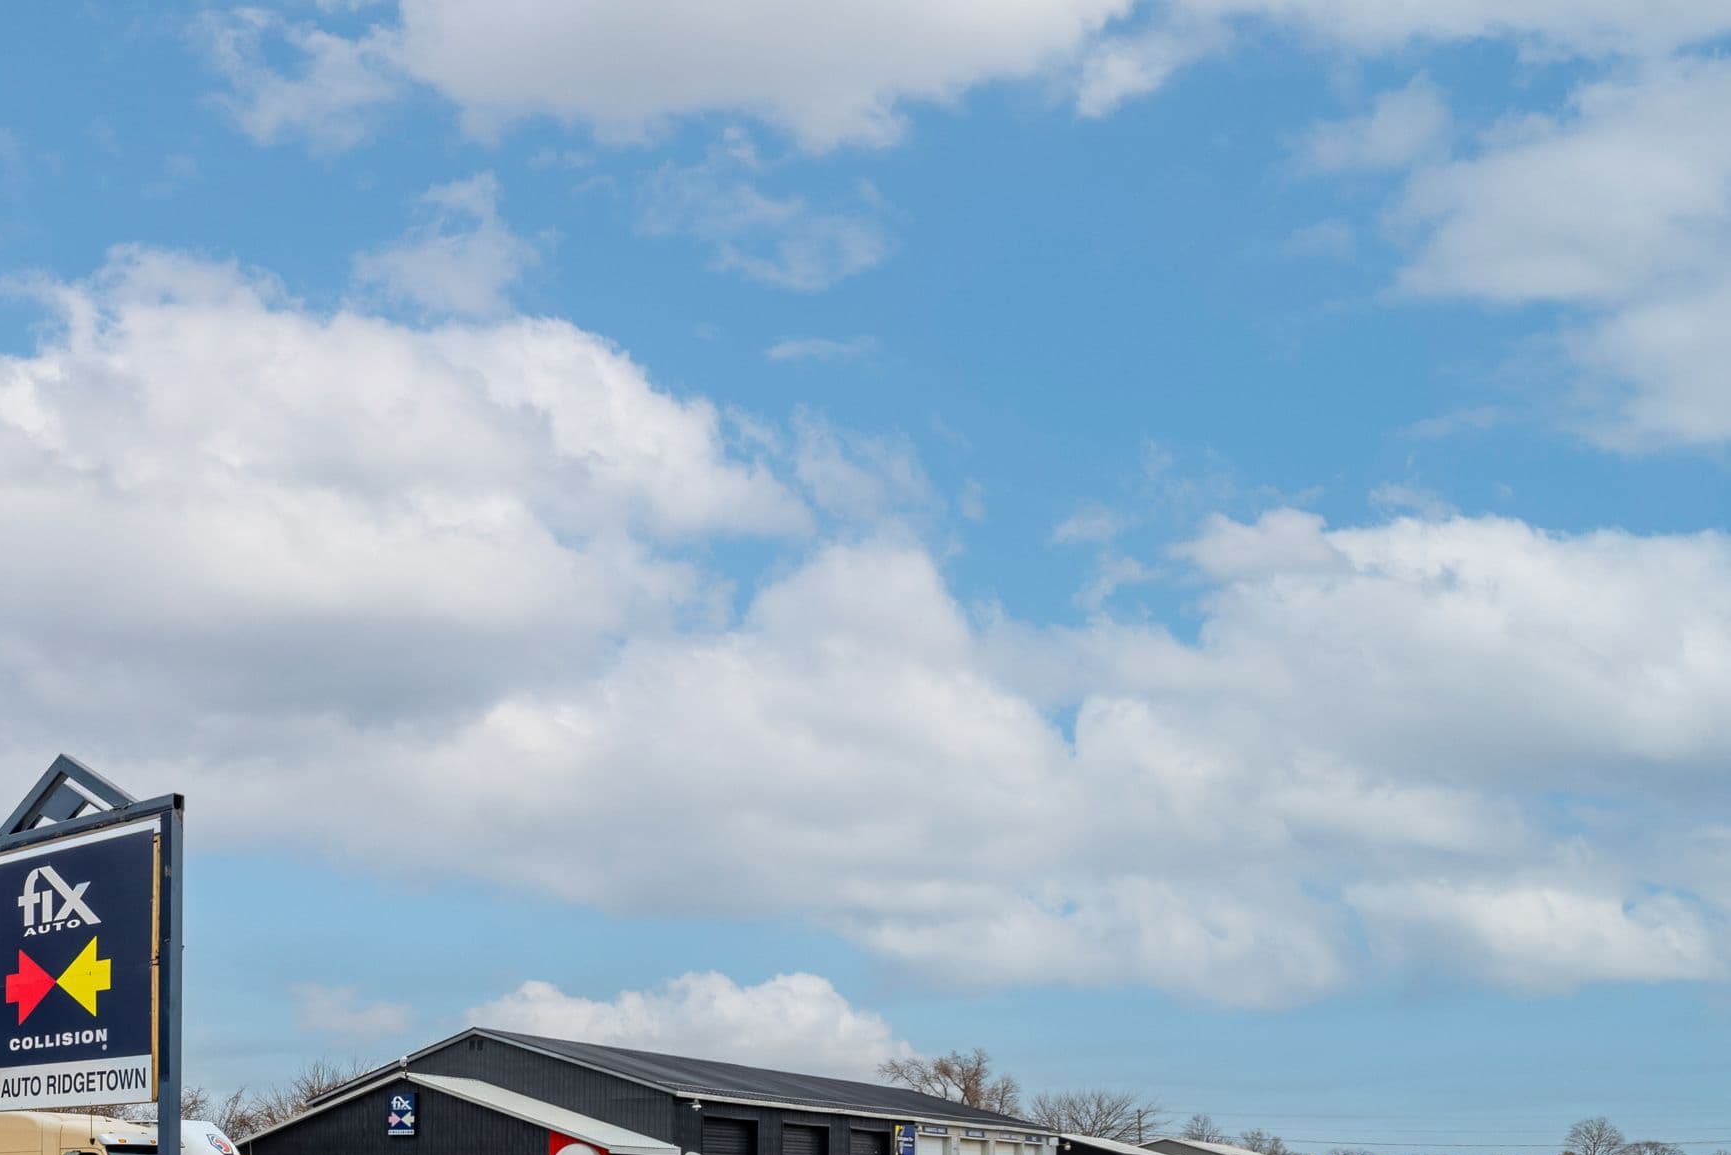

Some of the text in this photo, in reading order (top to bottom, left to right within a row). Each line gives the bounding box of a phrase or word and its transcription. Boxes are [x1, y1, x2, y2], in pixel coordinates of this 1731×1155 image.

[18, 866, 102, 926] fix
[23, 918, 81, 938] AUTO
[9, 1028, 108, 1051] COLLISION
[0, 1076, 41, 1098] AUTO
[46, 1067, 147, 1095] RIDGETOWN
